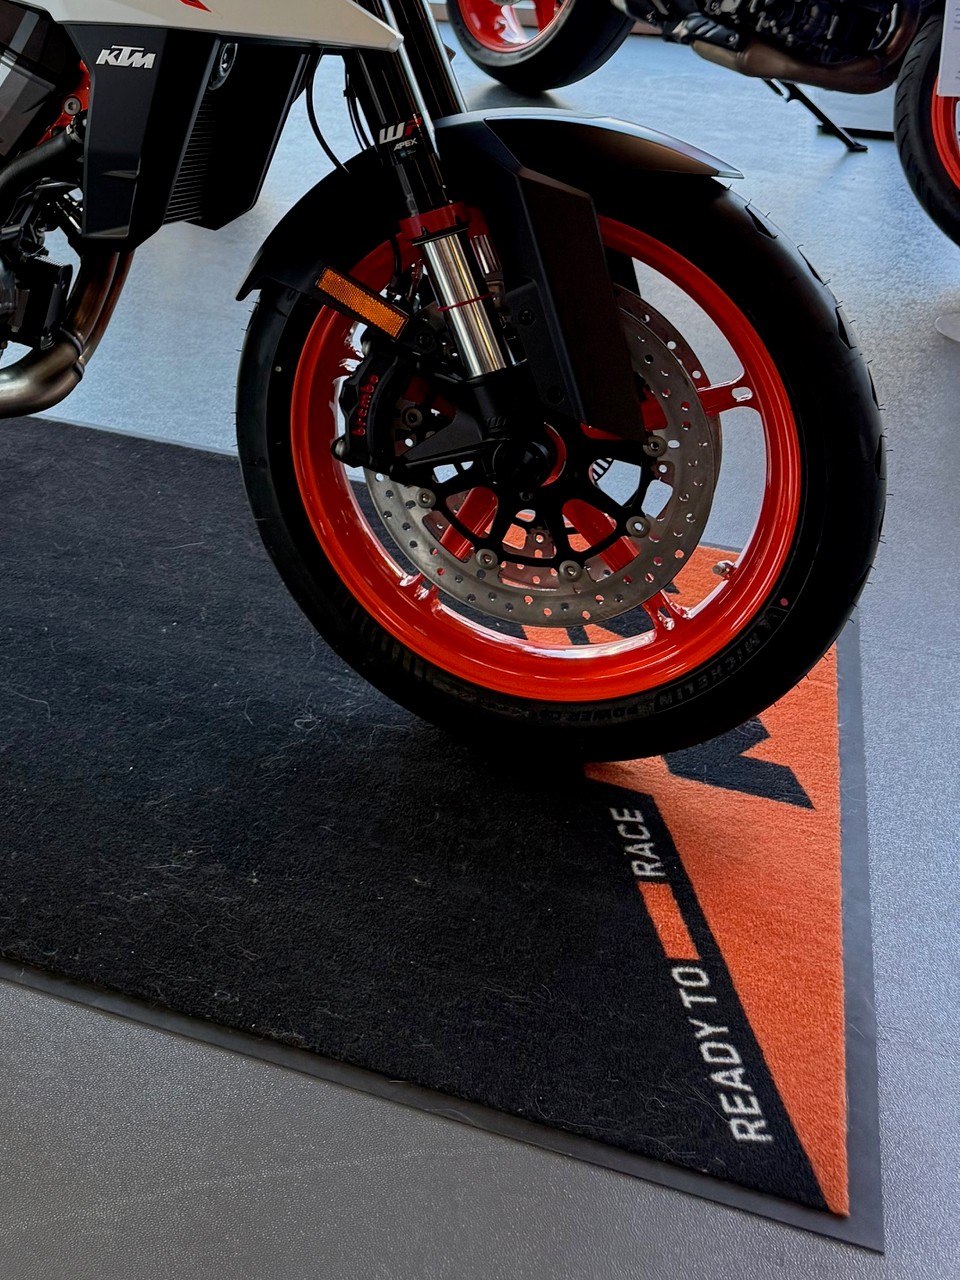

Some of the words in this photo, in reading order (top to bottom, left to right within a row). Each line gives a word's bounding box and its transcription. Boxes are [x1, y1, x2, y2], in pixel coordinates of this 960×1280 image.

[95, 44, 156, 69] KTM
[393, 138, 418, 151] APEX
[350, 373, 379, 437] brembo
[658, 631, 761, 708] MICHELIN
[570, 705, 639, 722] POWER
[611, 807, 667, 879] RACE
[670, 965, 717, 1009] TO
[699, 1019, 773, 1143] READY
